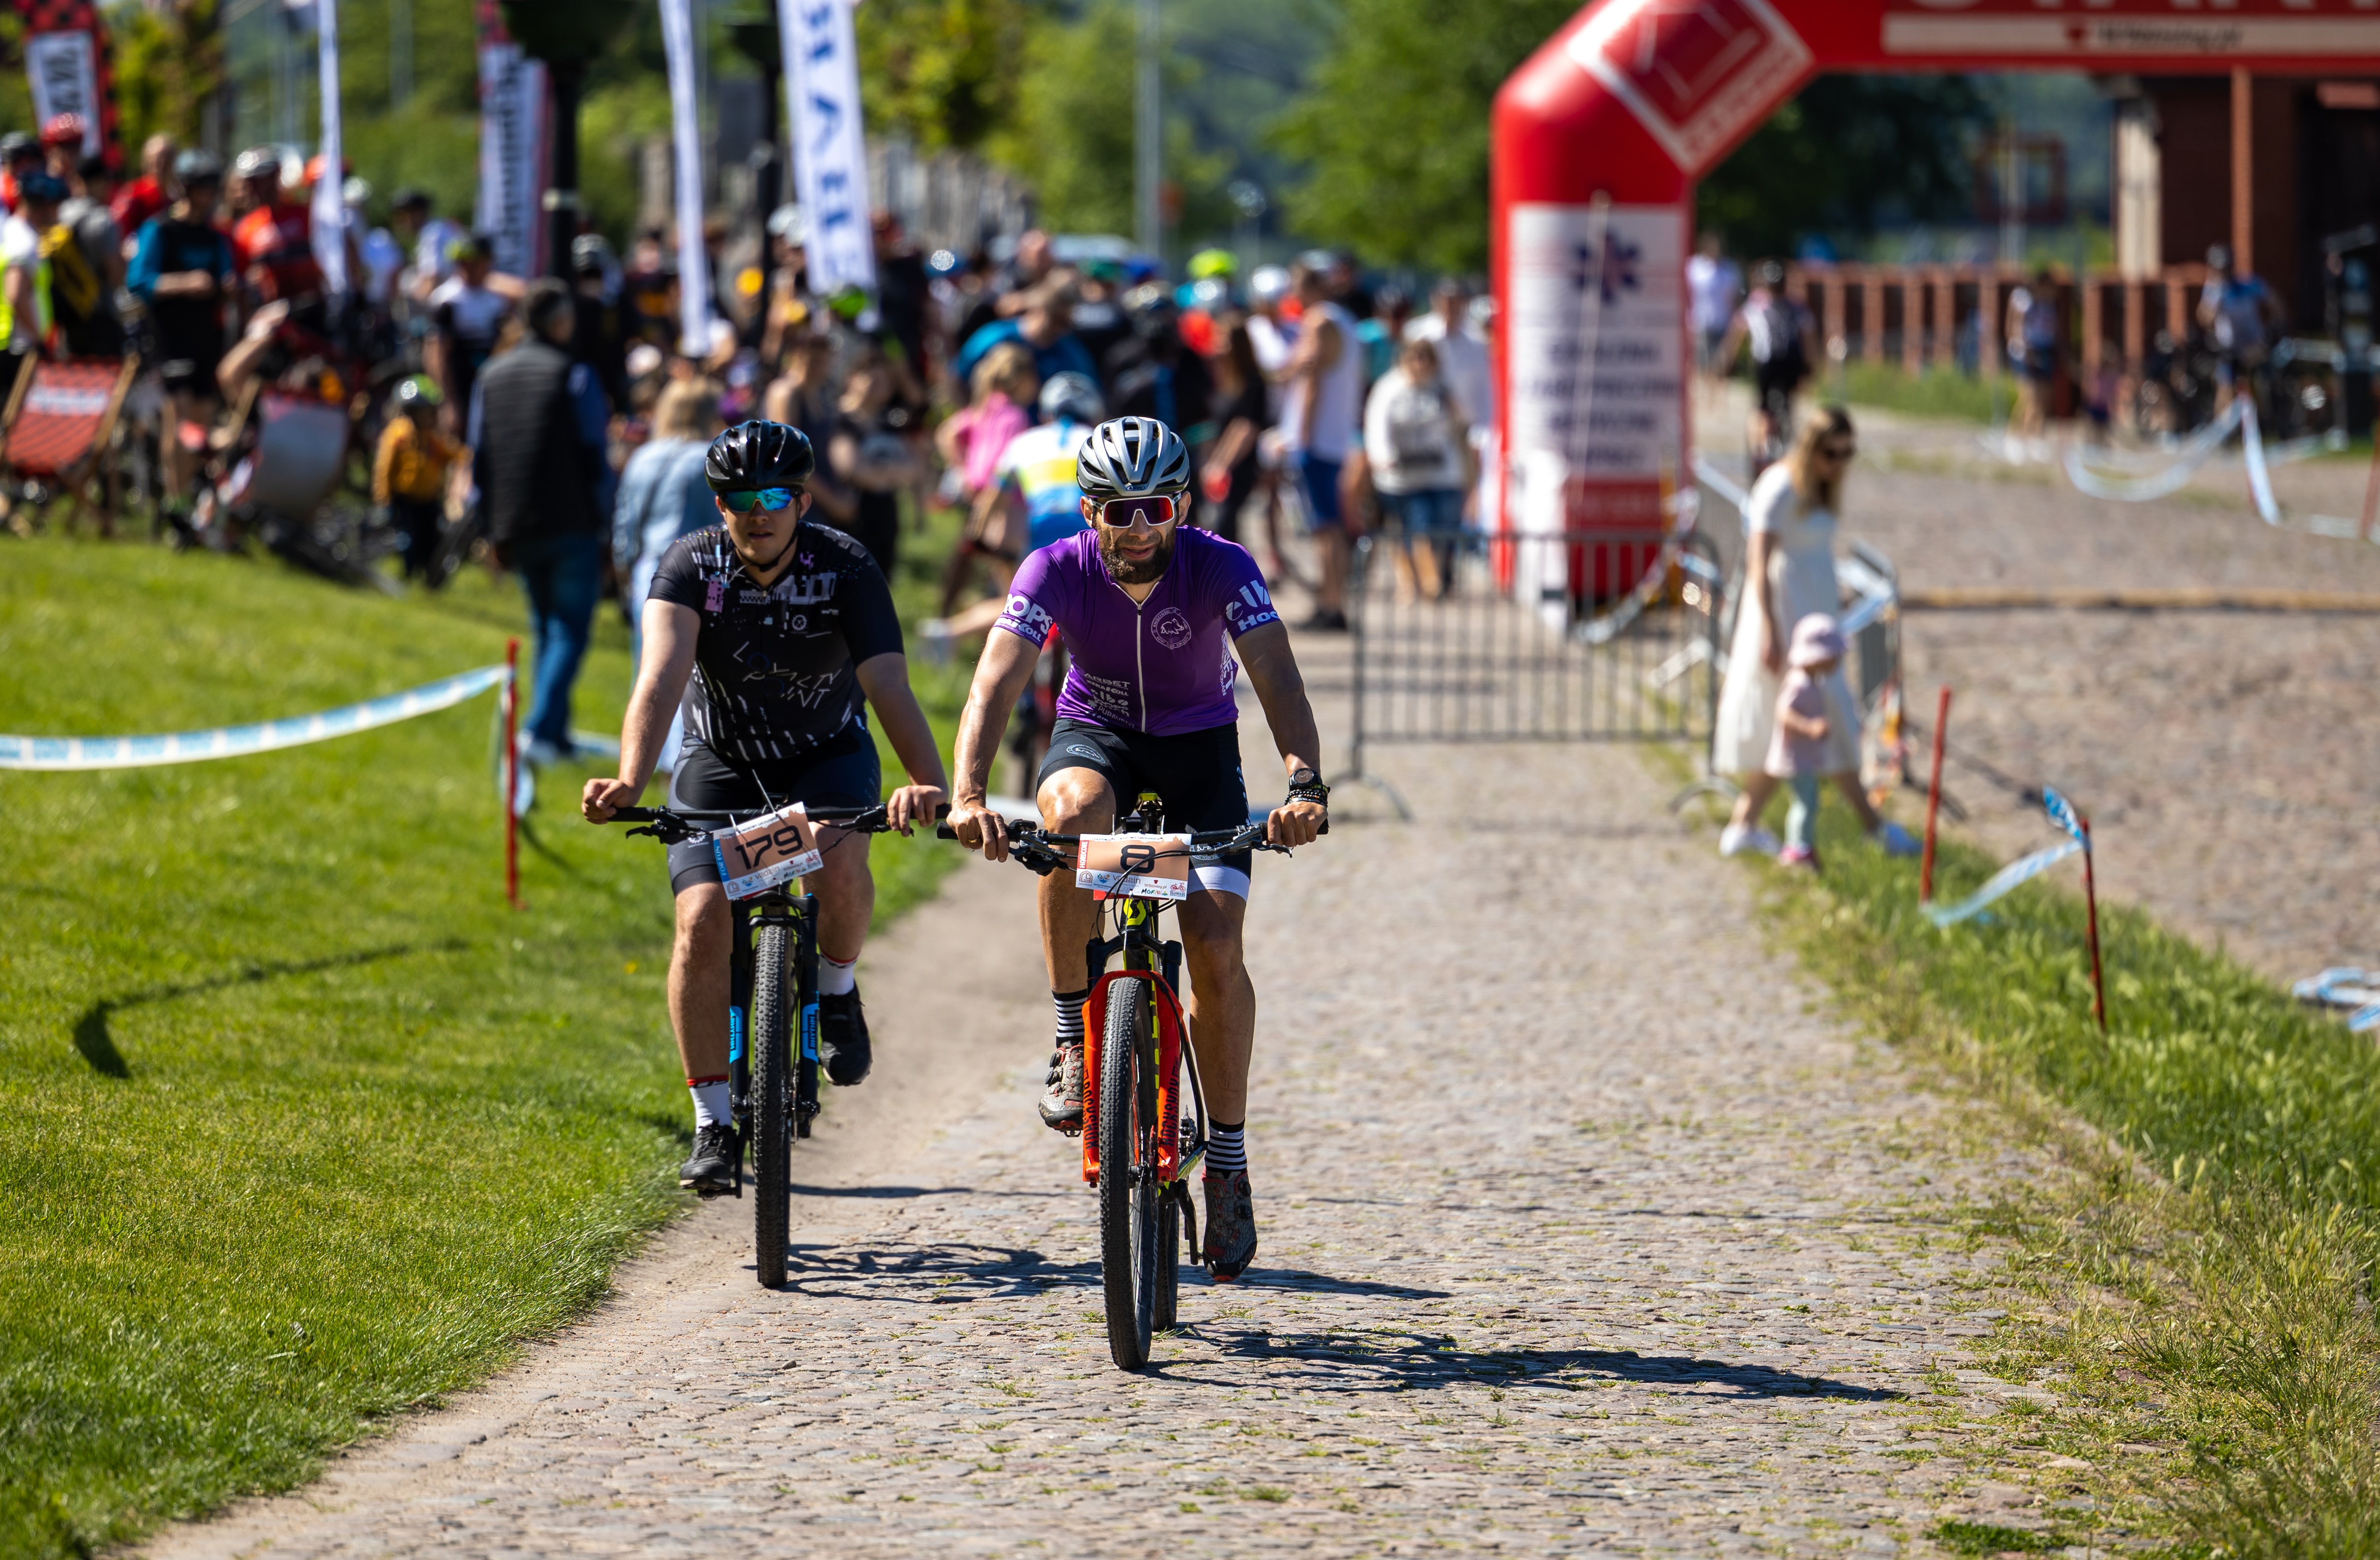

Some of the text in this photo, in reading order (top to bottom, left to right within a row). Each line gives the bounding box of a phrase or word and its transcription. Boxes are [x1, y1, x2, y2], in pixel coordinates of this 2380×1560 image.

[1084, 673, 1130, 688] ARBET
[734, 825, 803, 870] 179
[1079, 840, 1089, 869] HARDCORE
[718, 862, 727, 876] FOR
[1120, 844, 1156, 874] 8
[754, 866, 780, 879] vadain
